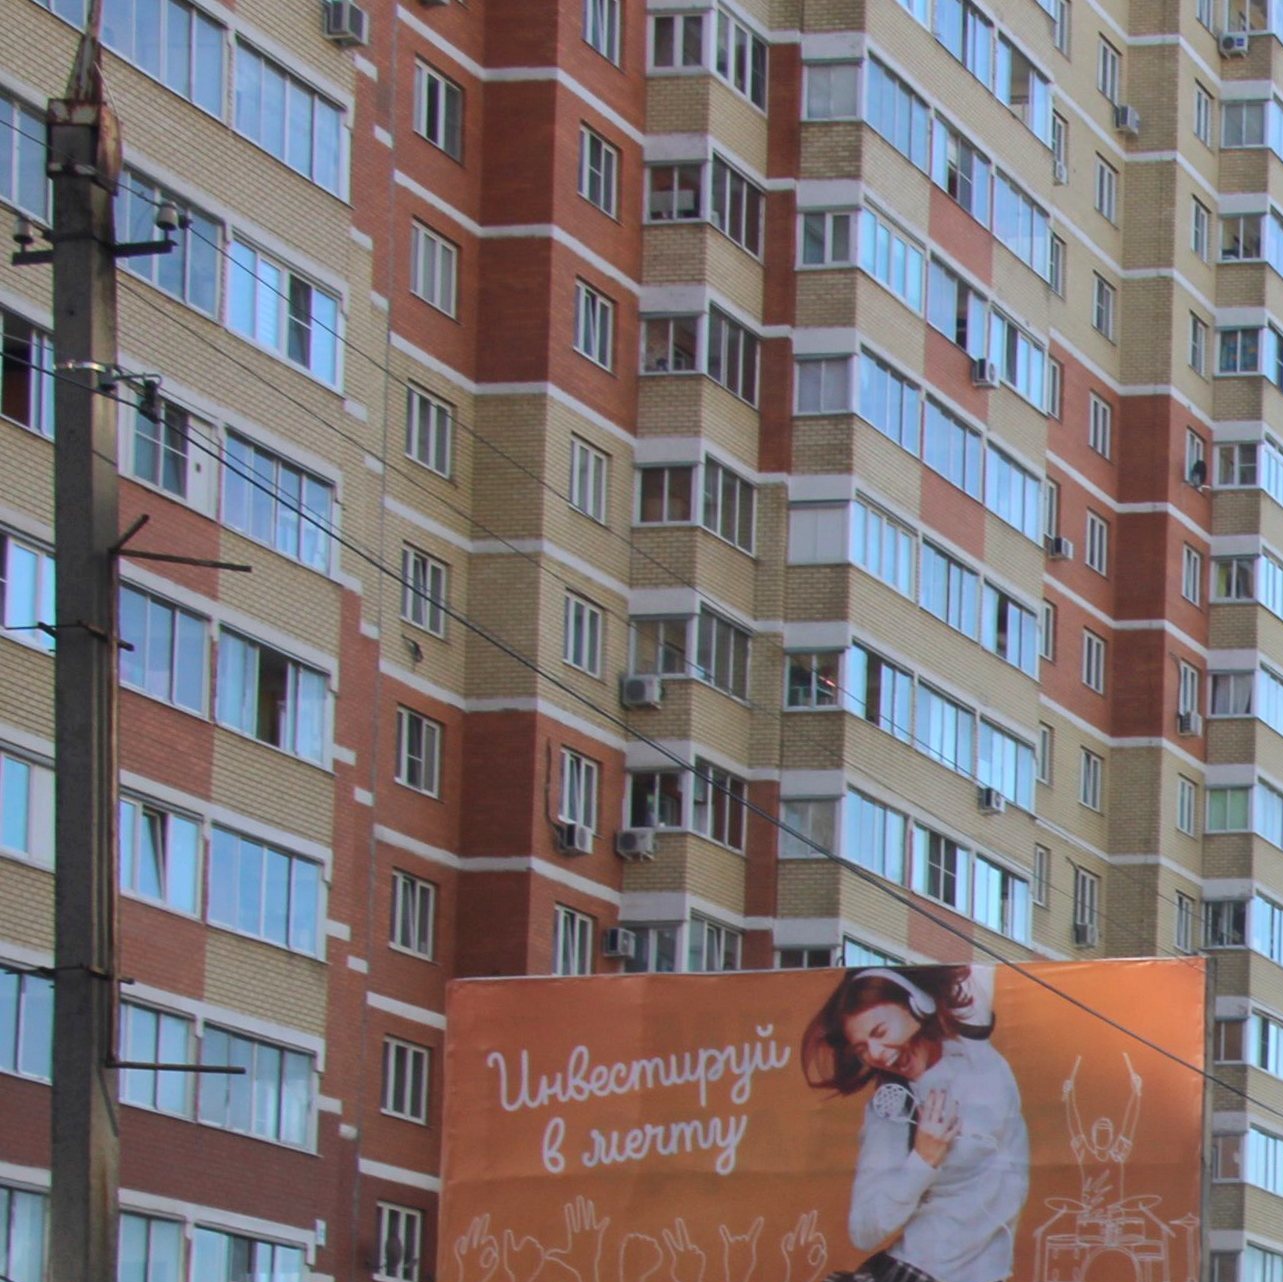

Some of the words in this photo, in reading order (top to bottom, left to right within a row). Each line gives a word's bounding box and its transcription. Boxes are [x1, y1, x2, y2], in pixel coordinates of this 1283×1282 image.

[488, 1024, 792, 1112] Инвестируй
[542, 1117, 566, 1174] в
[582, 1115, 747, 1175] мечту
